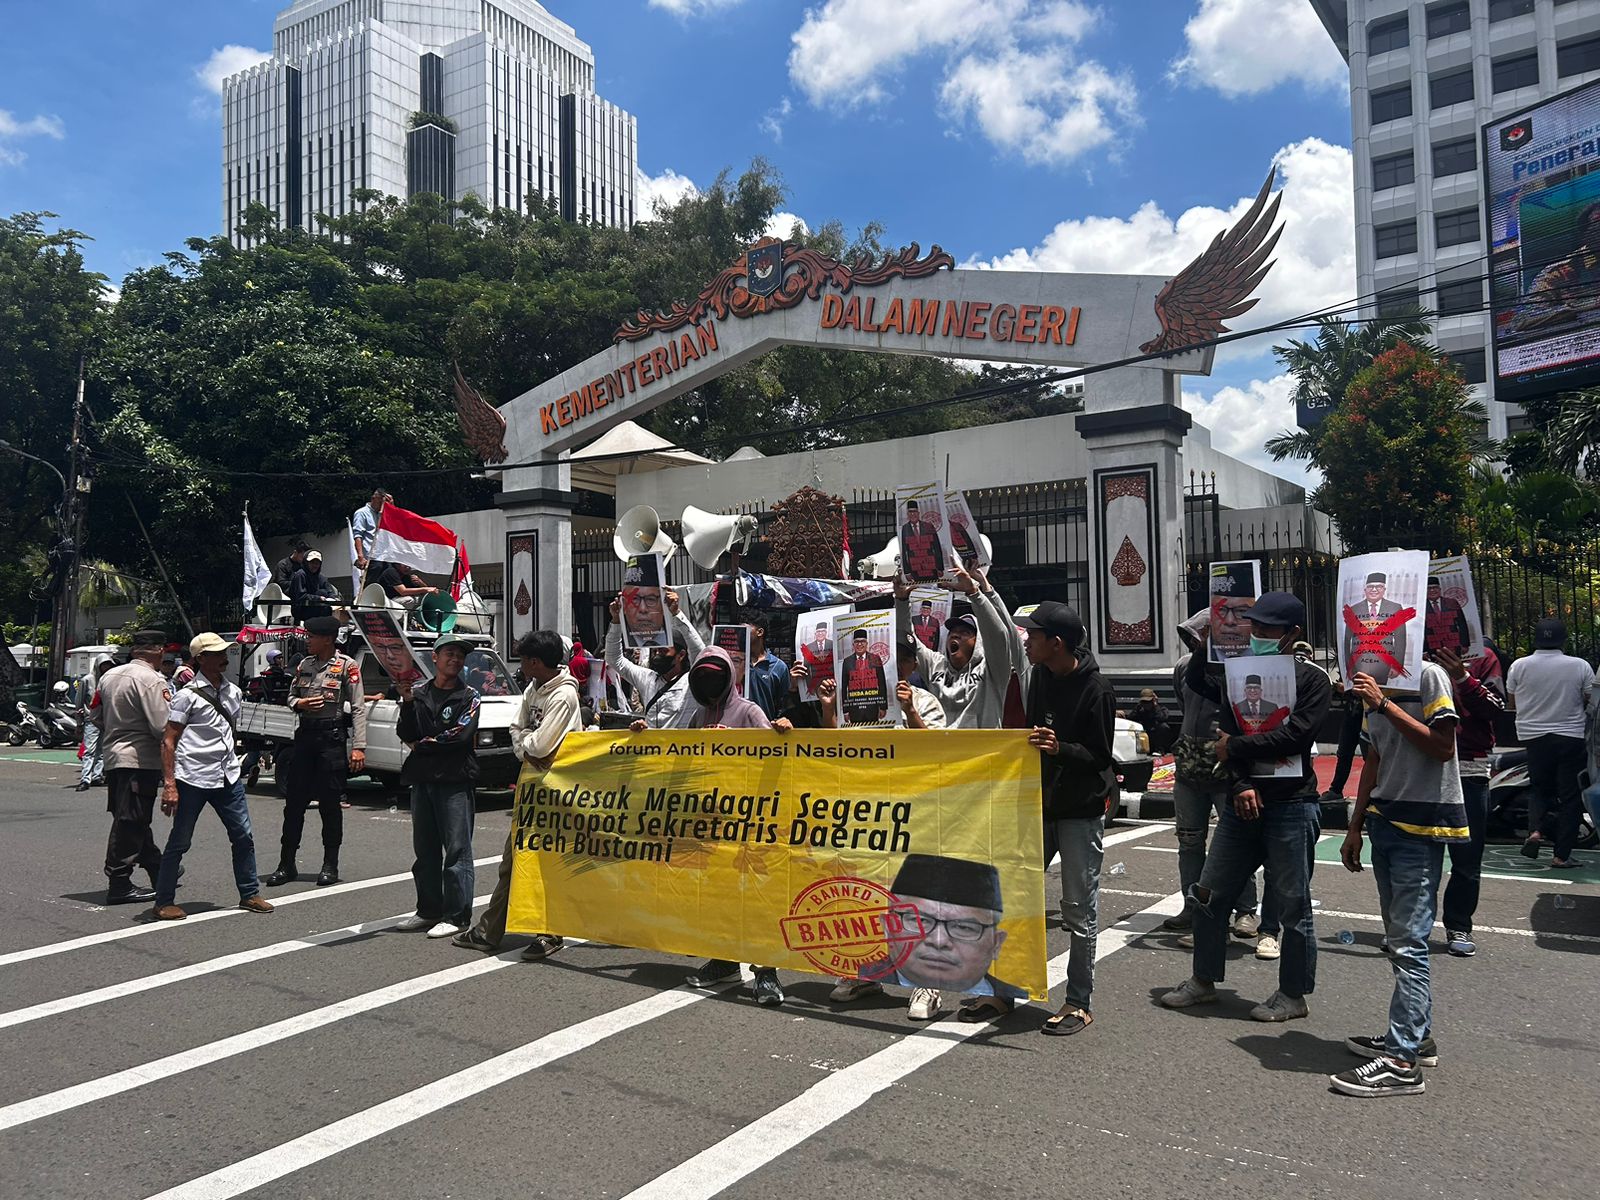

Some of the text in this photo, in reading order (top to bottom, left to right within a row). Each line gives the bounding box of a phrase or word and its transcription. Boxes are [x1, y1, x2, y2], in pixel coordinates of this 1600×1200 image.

[820, 293, 1081, 346] DALAM NEGERI
[539, 319, 718, 435] KEMENTERIAN
[609, 742, 896, 759] forum Anti Korupsi Nasional
[519, 783, 912, 828] Mendesak Mendagri Segera
[514, 828, 674, 863] Aceh Bustami
[516, 805, 911, 853] Mencopot Sekretaris Daerah
[810, 885, 873, 906] BANNED
[797, 913, 904, 943] BANNED
